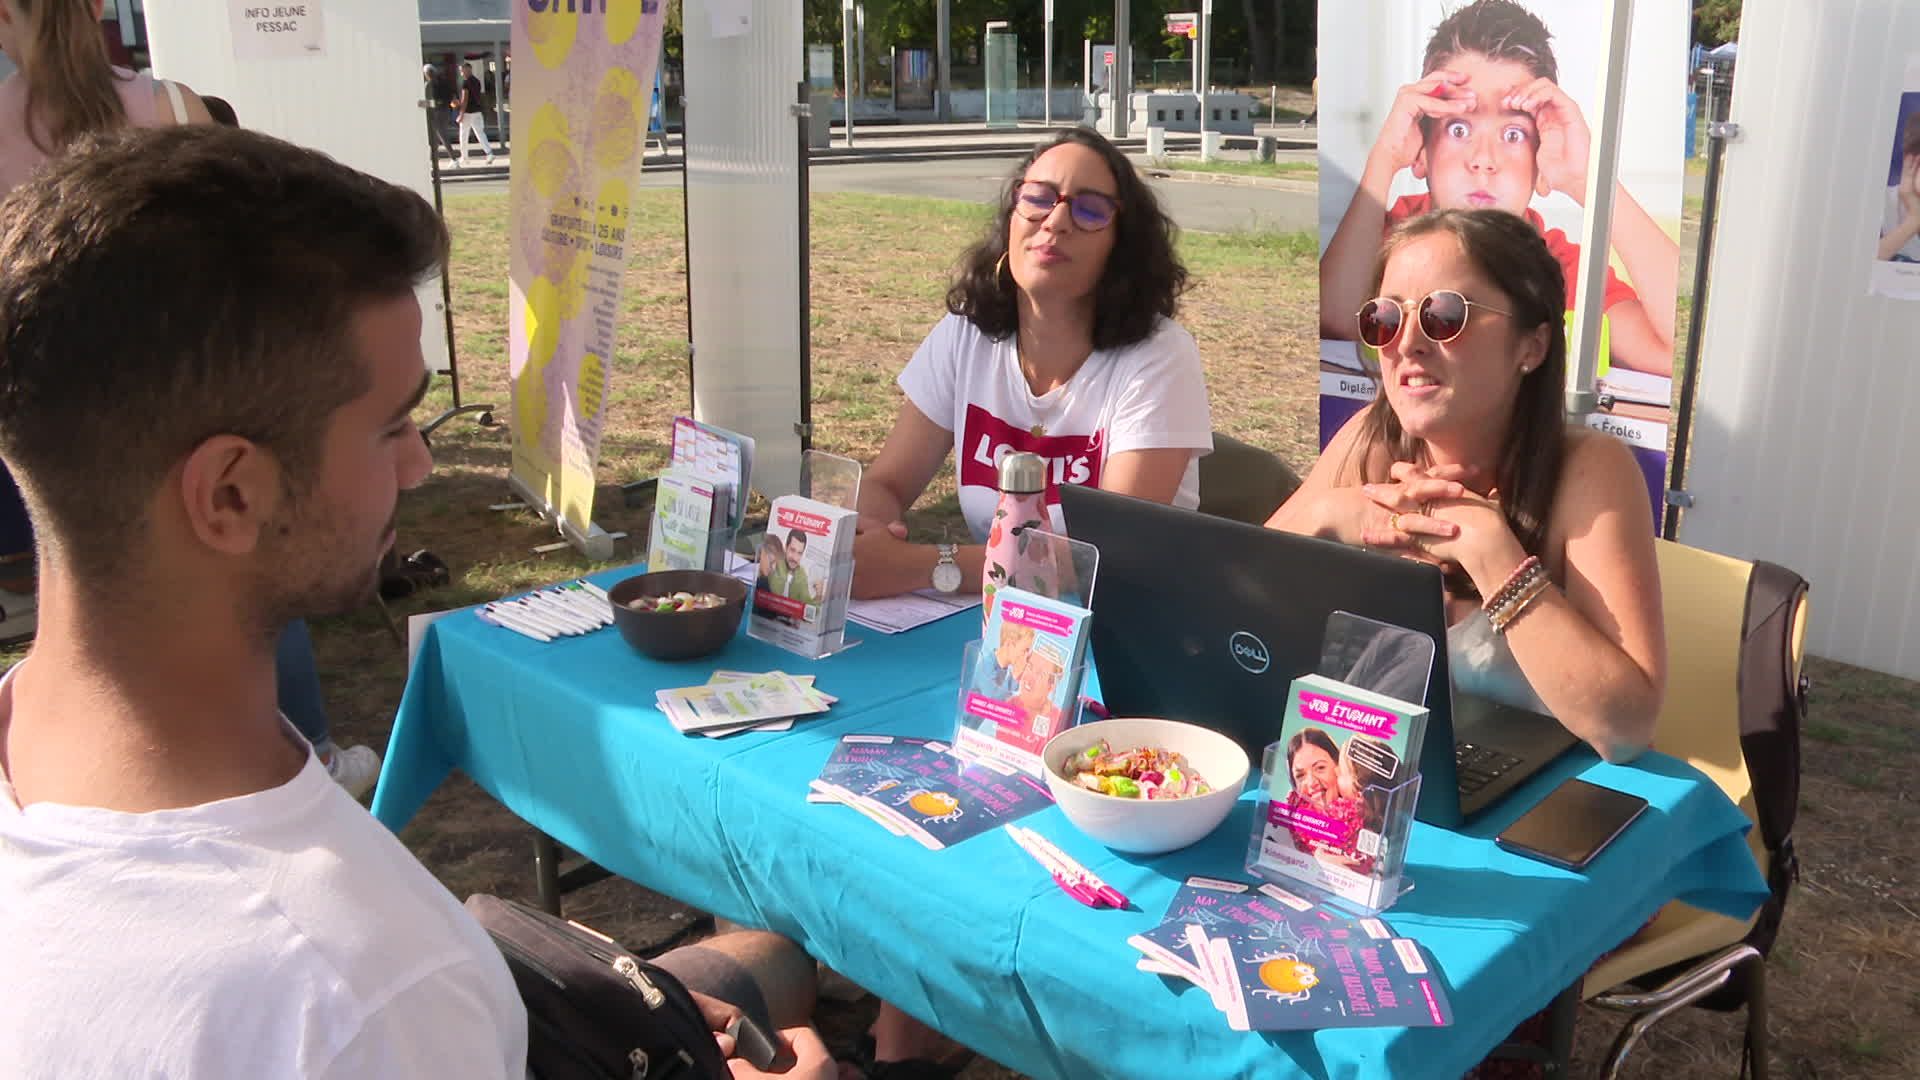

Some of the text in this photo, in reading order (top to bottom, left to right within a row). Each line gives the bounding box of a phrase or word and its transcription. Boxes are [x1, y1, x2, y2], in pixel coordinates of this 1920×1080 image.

[244, 5, 307, 18] INFO JEUNE
[256, 21, 298, 33] PESSAC
[974, 433, 1090, 484] LI'S
[1234, 643, 1267, 662] DELL
[1308, 698, 1388, 729] JOB ÉTUDIANT
